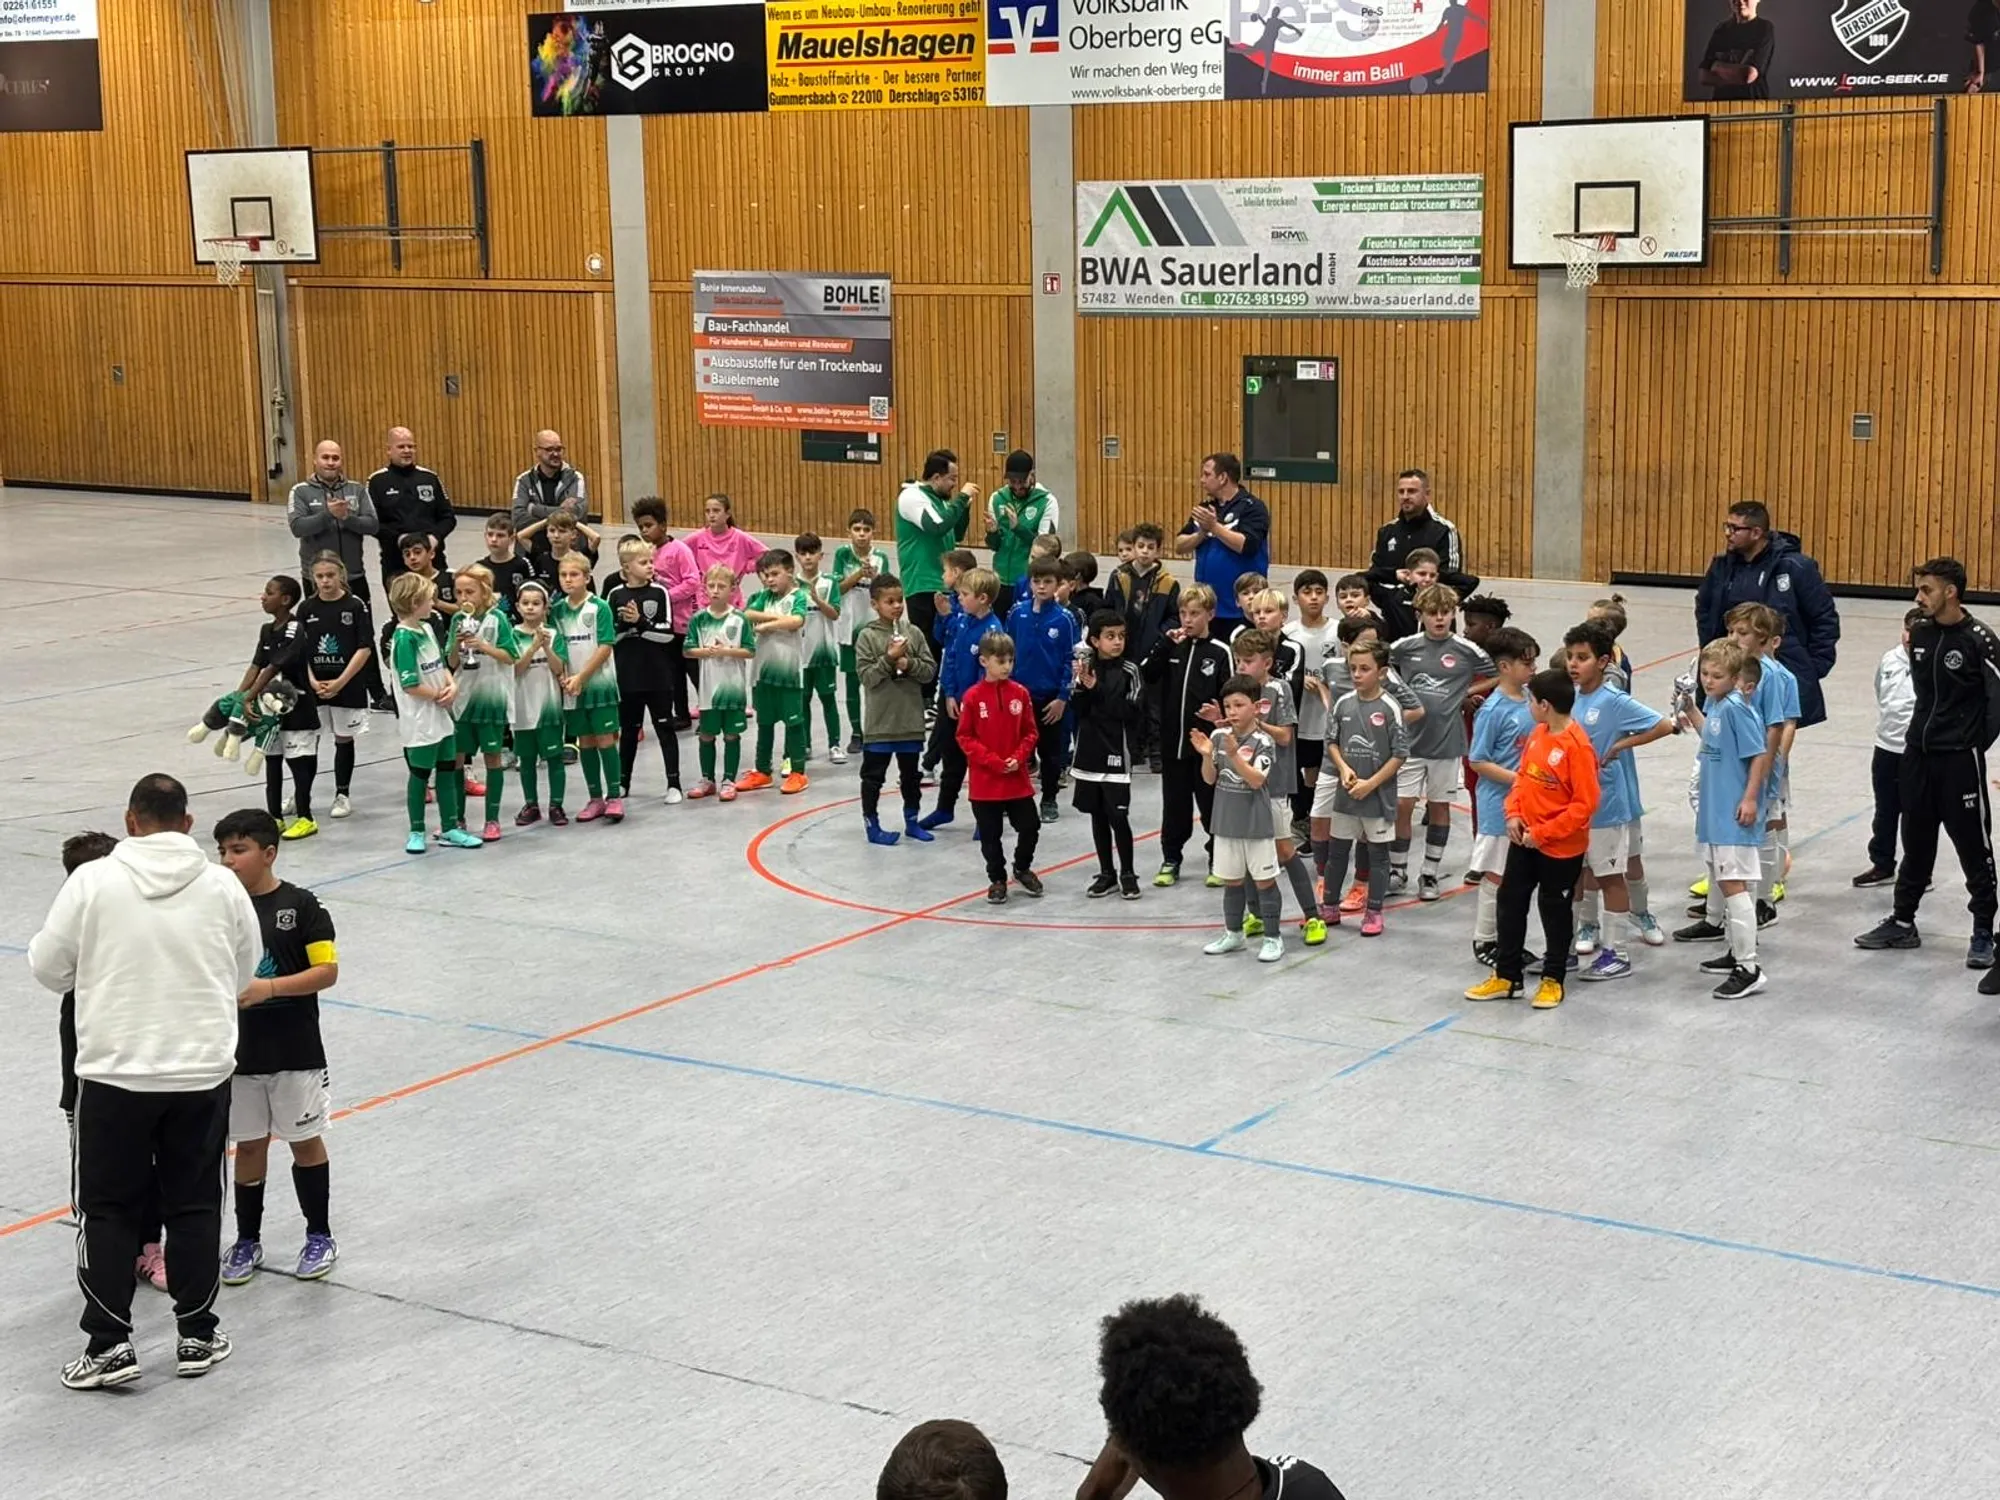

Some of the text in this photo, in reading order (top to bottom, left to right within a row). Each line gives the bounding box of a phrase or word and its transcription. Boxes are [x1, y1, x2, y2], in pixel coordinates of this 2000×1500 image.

[767, 8, 791, 21] Wenn
[793, 10, 802, 20] es
[805, 9, 818, 19] um
[960, 1, 980, 15] geht
[1361, 6, 1384, 17] Pe-S
[1840, 0, 1898, 39] DERSCHLAG
[1069, 20, 1223, 53] Oberberg eG
[652, 42, 734, 64] BROGNO
[777, 29, 976, 62] Mauelshagen
[652, 66, 705, 77] GROUP
[1070, 60, 1222, 79] Wir machen den Weg frei
[1293, 61, 1404, 83] immer am Ball!
[770, 73, 789, 87] Holz
[798, 70, 870, 86] Baustoffmärkte
[883, 70, 899, 85] Der
[904, 69, 940, 84] bessere
[946, 68, 981, 83] Partner
[769, 87, 985, 106] Gummersbach 22010 Derschlag 53167
[1072, 83, 1222, 98] www.volksbank-oberberg.de
[1340, 180, 1478, 193] Trockene Wände ohne Ausschachten!
[1322, 201, 1350, 214] Energie
[1352, 200, 1388, 213] einsparen
[1390, 200, 1409, 211] dank
[1411, 200, 1448, 210] trockener
[1367, 237, 1475, 250] Feuchte Keller trockenlegen!
[1366, 256, 1473, 268] Kostenlose Schadenanalyse!
[1081, 253, 1336, 287] BWA Sauerland GmbH
[1366, 273, 1461, 284] Jetzt Termin vereinbaren!
[823, 285, 880, 304] BOHLE
[1081, 292, 1475, 306] 57482 Wenden Tel. 02762-9819499 www.bwa-sauerland.de
[708, 320, 790, 334] Bau-Fachhandel
[709, 337, 719, 346] Für
[798, 340, 811, 348] und
[710, 357, 883, 373] Ausbaustoffe für den Trockenbau
[711, 373, 780, 387] Bauelemente
